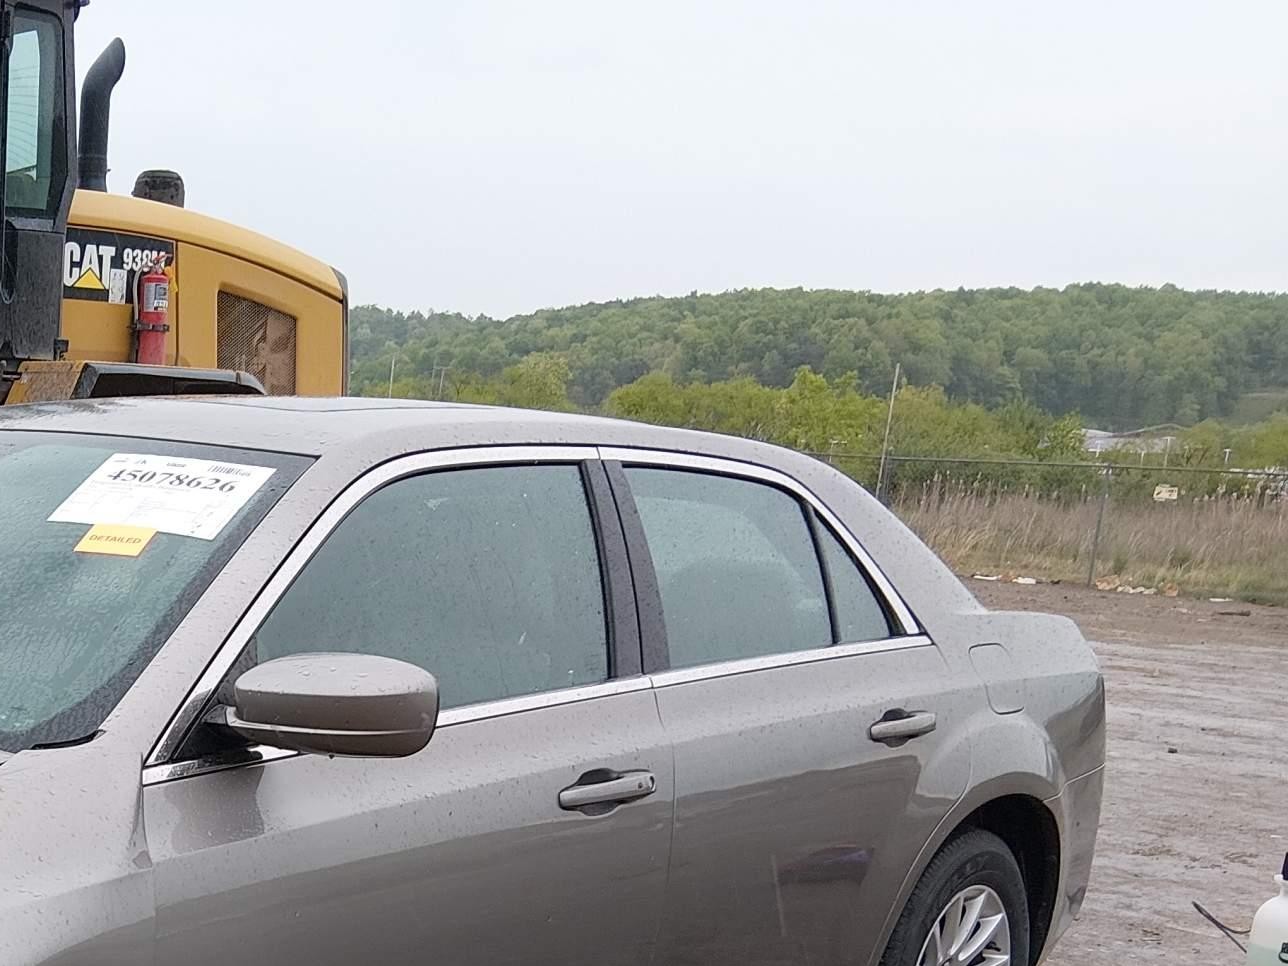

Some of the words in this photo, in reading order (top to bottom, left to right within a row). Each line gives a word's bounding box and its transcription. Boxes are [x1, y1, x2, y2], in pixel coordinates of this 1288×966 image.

[64, 241, 116, 290] CAT
[108, 468, 237, 493] 45078626
[88, 533, 142, 545] DETAILED
